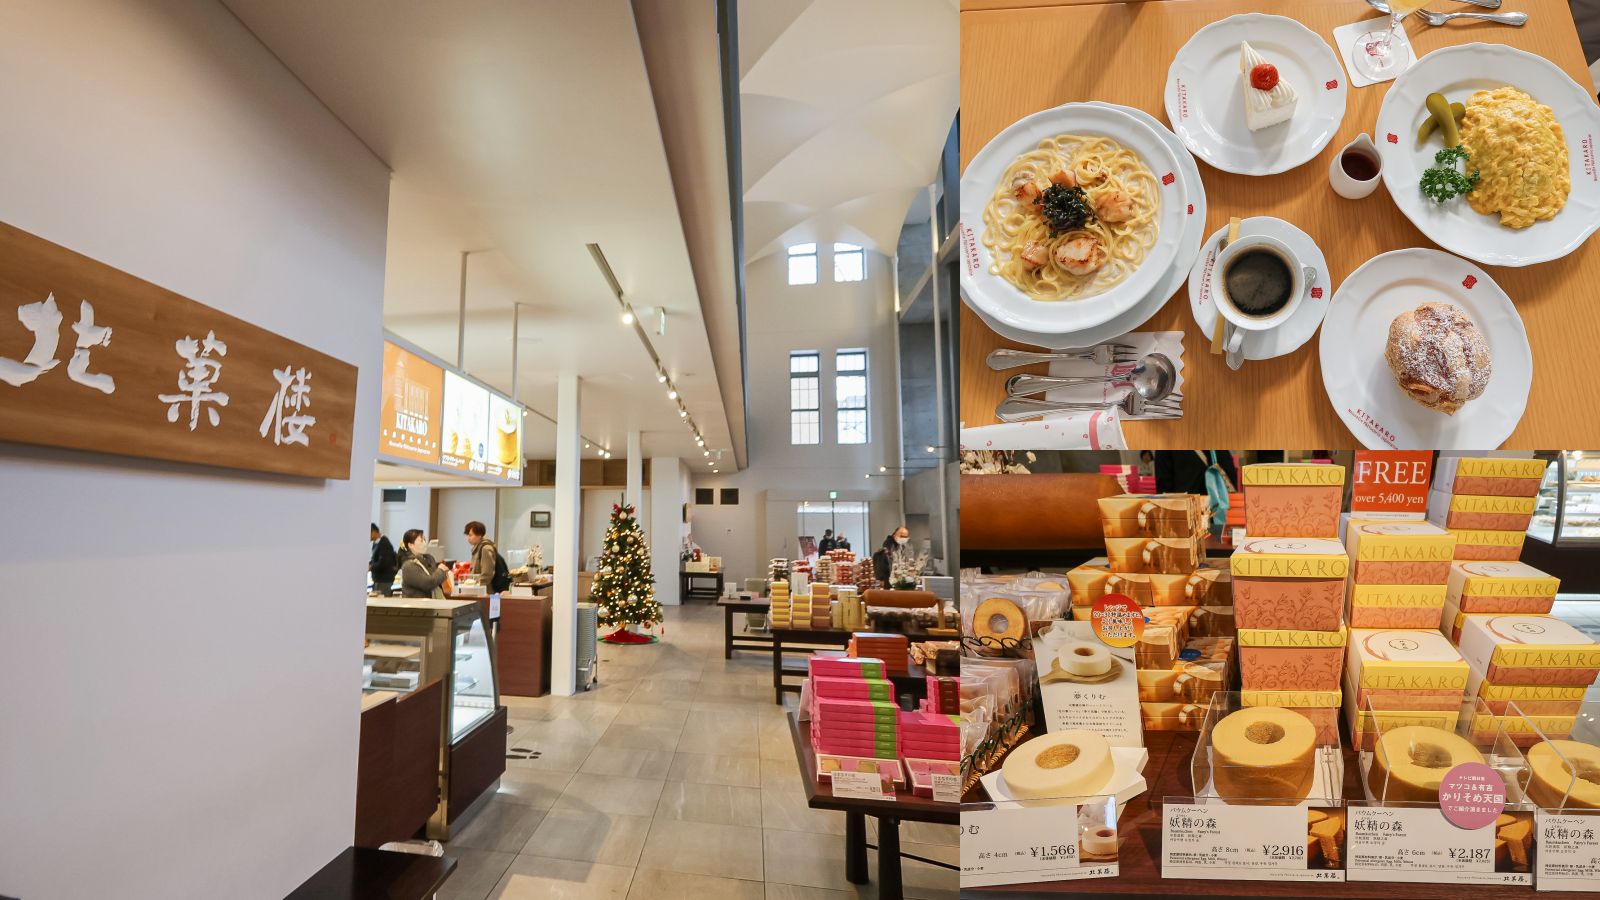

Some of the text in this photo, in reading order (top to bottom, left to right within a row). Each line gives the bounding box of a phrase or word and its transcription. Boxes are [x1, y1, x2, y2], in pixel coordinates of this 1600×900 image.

[1582, 139, 1591, 175] KITAKARO
[966, 228, 980, 269] KITAKARO
[1357, 408, 1395, 442] KITAKARO
[1243, 468, 1342, 484] KITAKARO
[1355, 461, 1427, 485] FREE
[1460, 462, 1545, 477] KITAKARO
[1355, 492, 1424, 507] over 5,400 yen
[1454, 498, 1535, 513] KITAKARO
[1456, 531, 1525, 545] ITAKARO
[1360, 545, 1453, 560] KITAKARO
[1231, 559, 1347, 577] KITAKARO
[1468, 582, 1557, 597] KITAKARO
[1356, 593, 1444, 607] KITAKARO
[1240, 631, 1344, 646] KITAKARO
[1364, 674, 1465, 689] KITAKARO
[1242, 692, 1341, 707] KITAKARO
[1487, 686, 1585, 699] KITAKARO
[1442, 792, 1504, 804] かりそめ天国
[1169, 817, 1217, 829] 妖精の森
[1354, 820, 1403, 832] 妖精の森
[1544, 828, 1594, 840] 妖精の森
